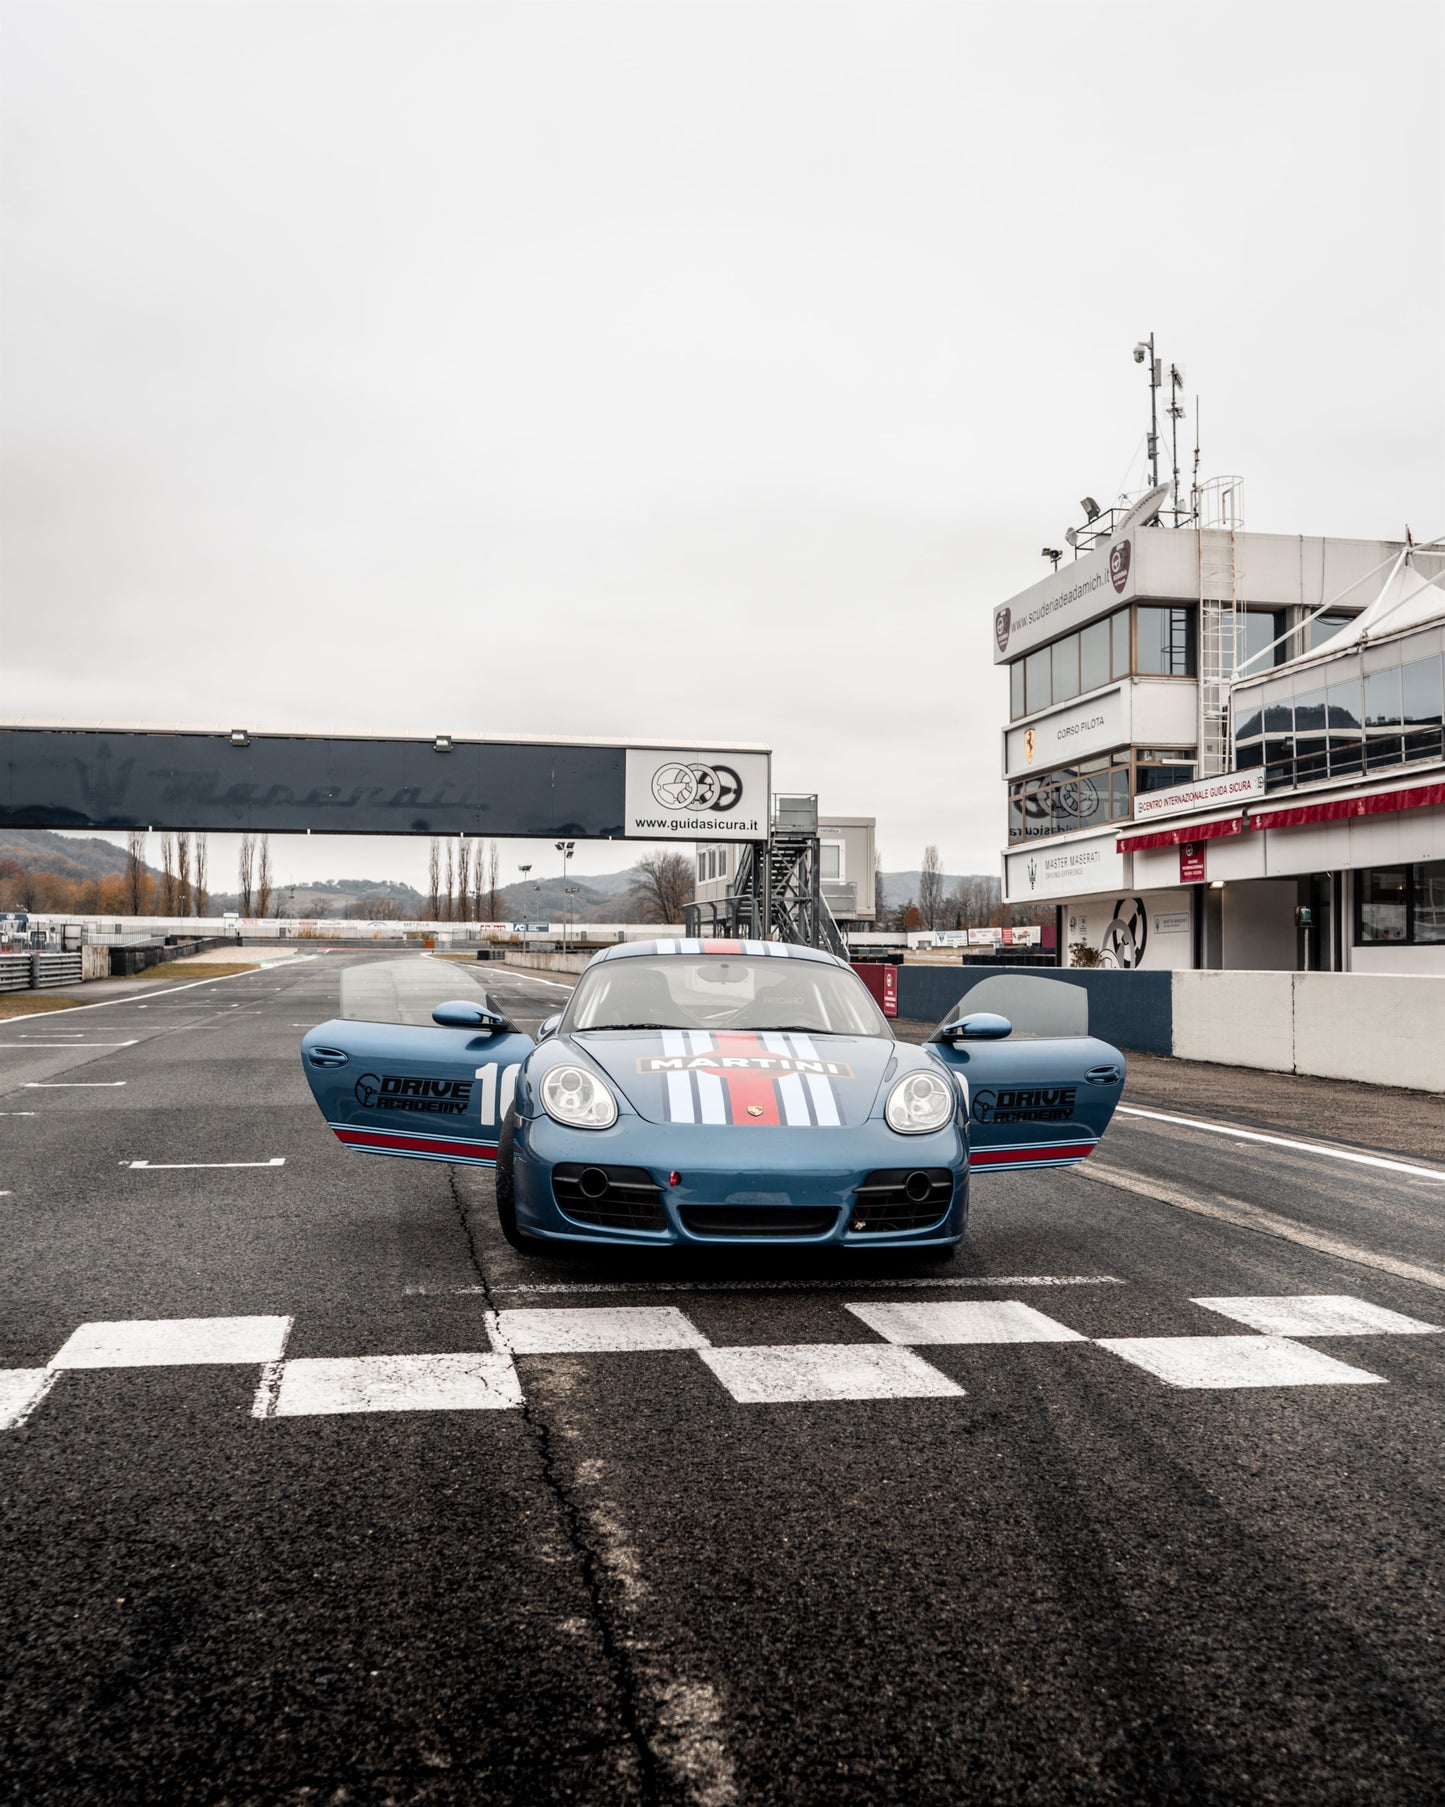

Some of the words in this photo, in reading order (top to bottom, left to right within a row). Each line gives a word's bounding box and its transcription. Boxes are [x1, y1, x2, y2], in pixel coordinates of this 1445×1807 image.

[1011, 568, 1110, 633] www.scuderiadeadamich.it
[1057, 724, 1080, 740] CORSO
[1081, 716, 1105, 732] PILOTA
[1143, 798, 1162, 811] CENTRO
[1163, 789, 1208, 806] INTERNAZIONALE
[1210, 785, 1228, 798] GUIDA
[1229, 780, 1252, 794] SICURA
[635, 818, 758, 831] www.guidasicura.it
[1045, 857, 1068, 870] MASTER
[1069, 851, 1101, 866] MASERATI
[651, 1057, 839, 1075] MARTINI
[380, 1077, 473, 1099] DRIVE
[376, 1098, 468, 1114] ACADEMY
[997, 1089, 1077, 1108] DRIVE
[993, 1108, 1074, 1124] ACADEMY
